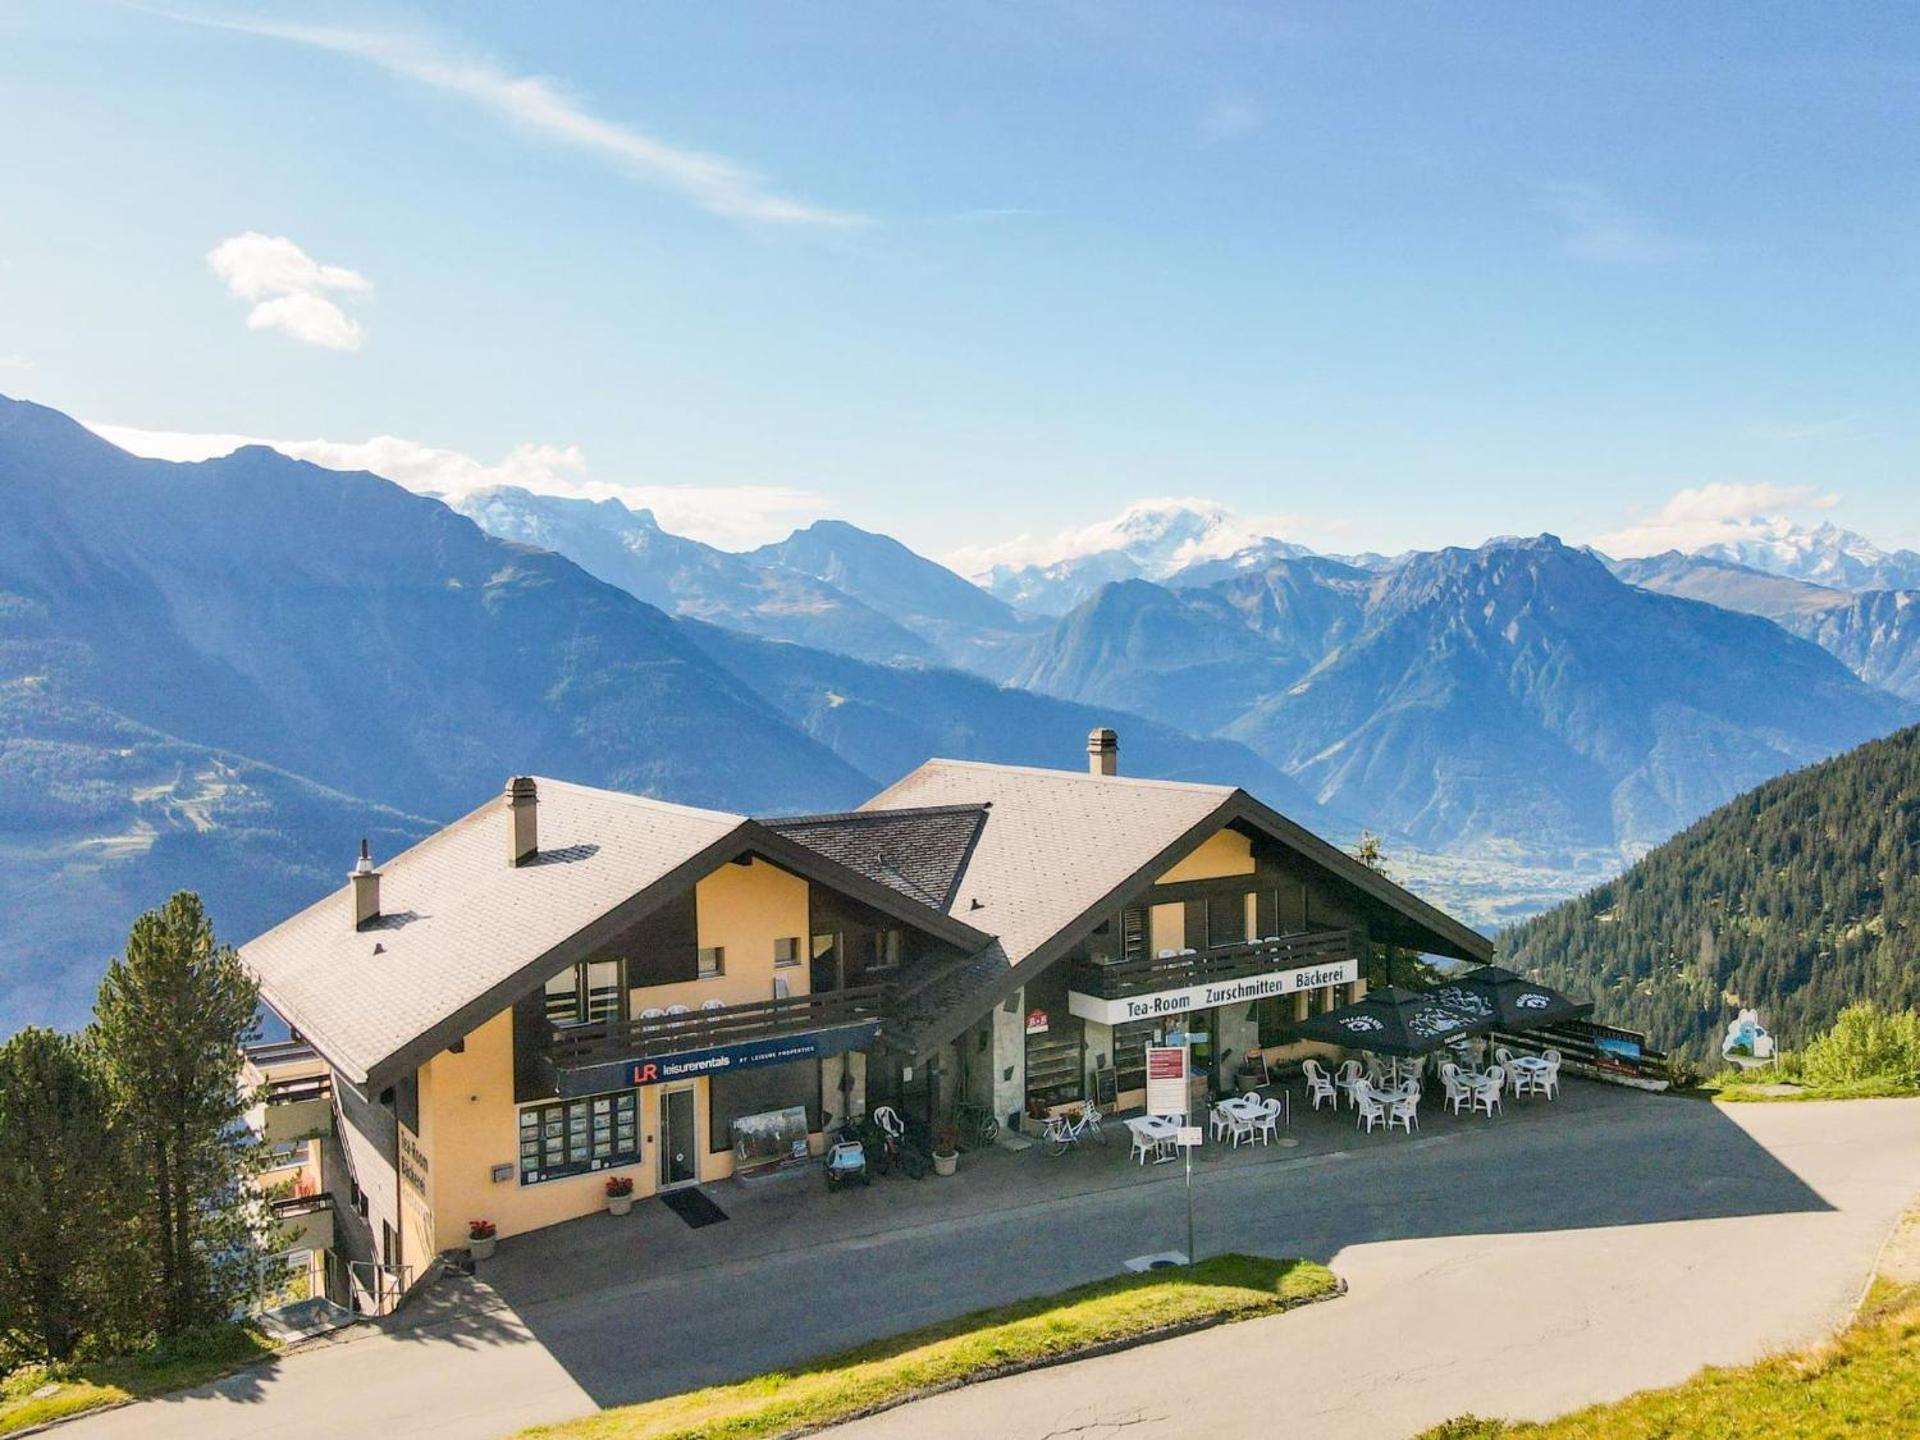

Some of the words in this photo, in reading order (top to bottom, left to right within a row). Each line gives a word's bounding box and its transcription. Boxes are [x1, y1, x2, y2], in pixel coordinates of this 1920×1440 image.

[1127, 995, 1190, 1017] Tea-Room
[1205, 978, 1283, 1004] Zurschmitten
[1295, 965, 1344, 988] Bäckerei
[633, 1063, 657, 1083] LR
[662, 1055, 731, 1077] leisurerentals
